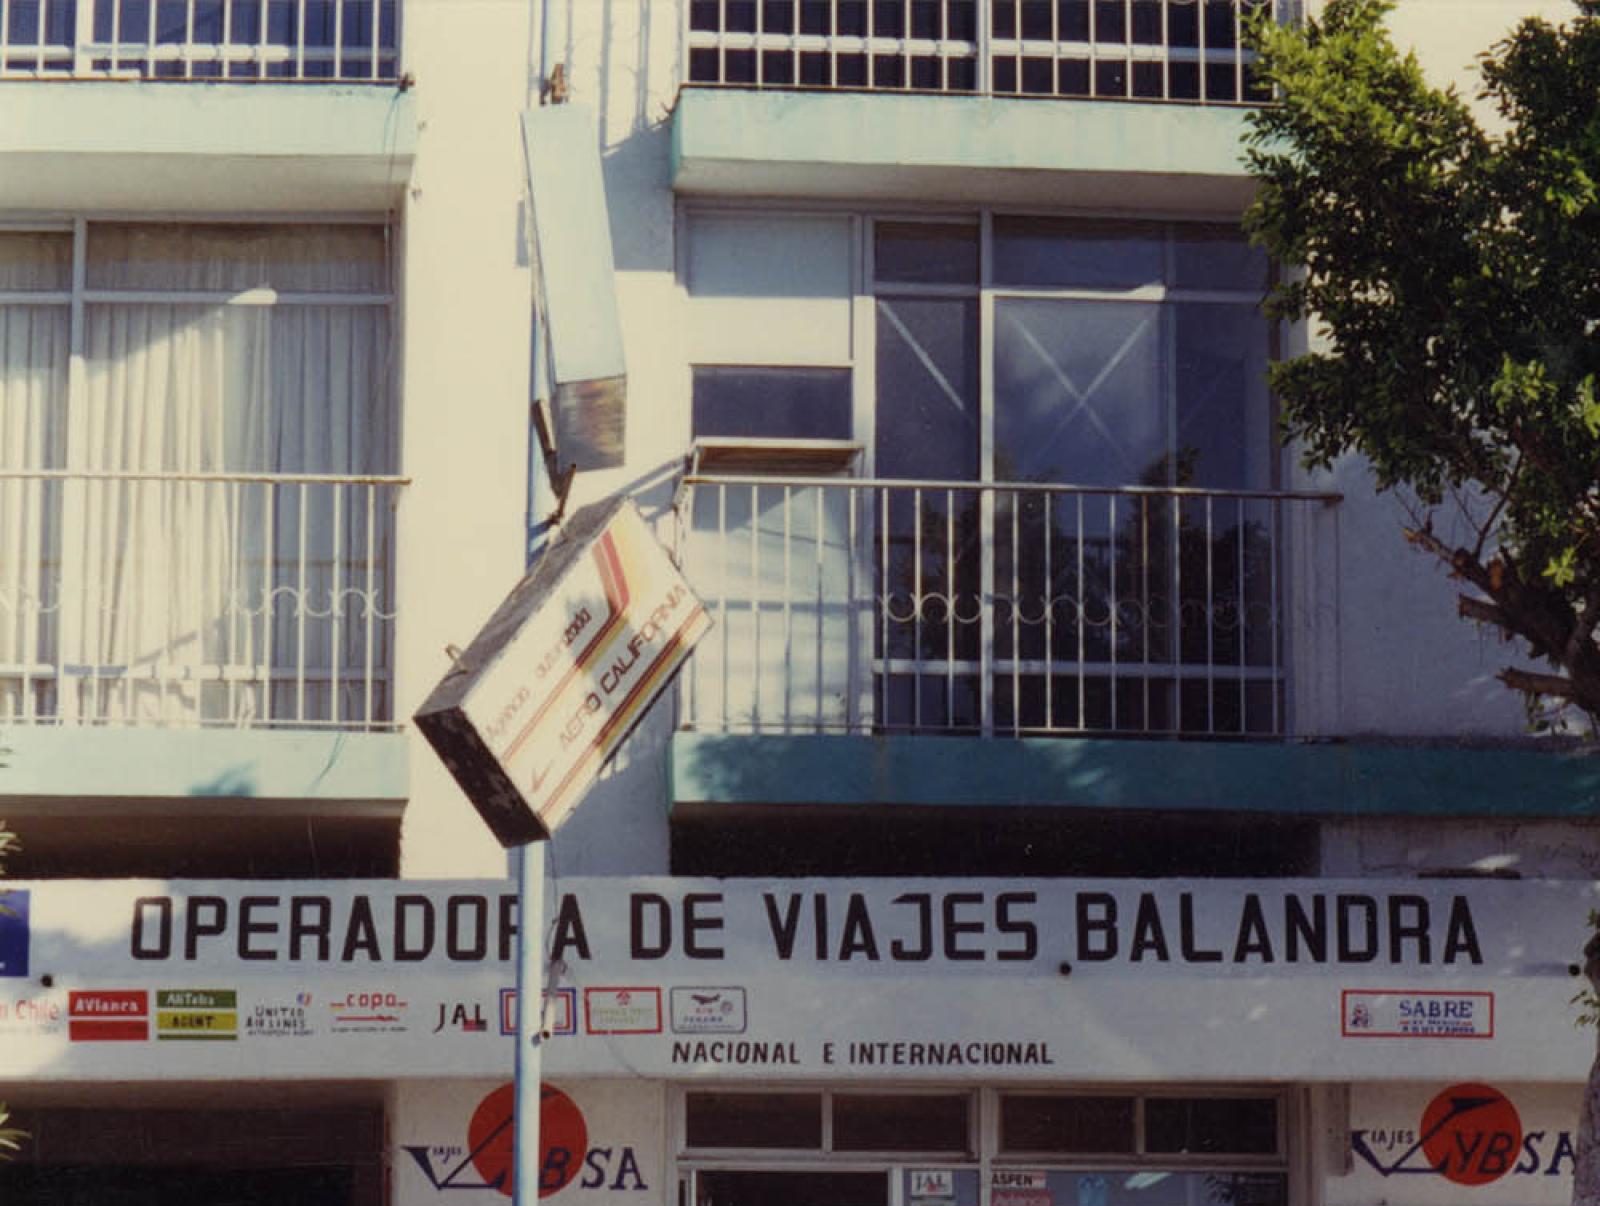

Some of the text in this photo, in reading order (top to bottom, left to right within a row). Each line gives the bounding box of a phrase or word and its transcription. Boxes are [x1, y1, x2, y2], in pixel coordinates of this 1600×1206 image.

[559, 583, 687, 752] AERO CALIFORNIA
[630, 893, 725, 961] DE
[763, 892, 1038, 962] VIAJES
[1075, 892, 1484, 965] BALANDRA
[432, 1003, 488, 1034] JAL
[1399, 999, 1474, 1019] SABRE
[671, 1041, 1055, 1067] NACIONAL E INTERNACIONAL
[915, 1173, 951, 1193] JAL
[991, 1174, 1034, 1187] ASPEN
